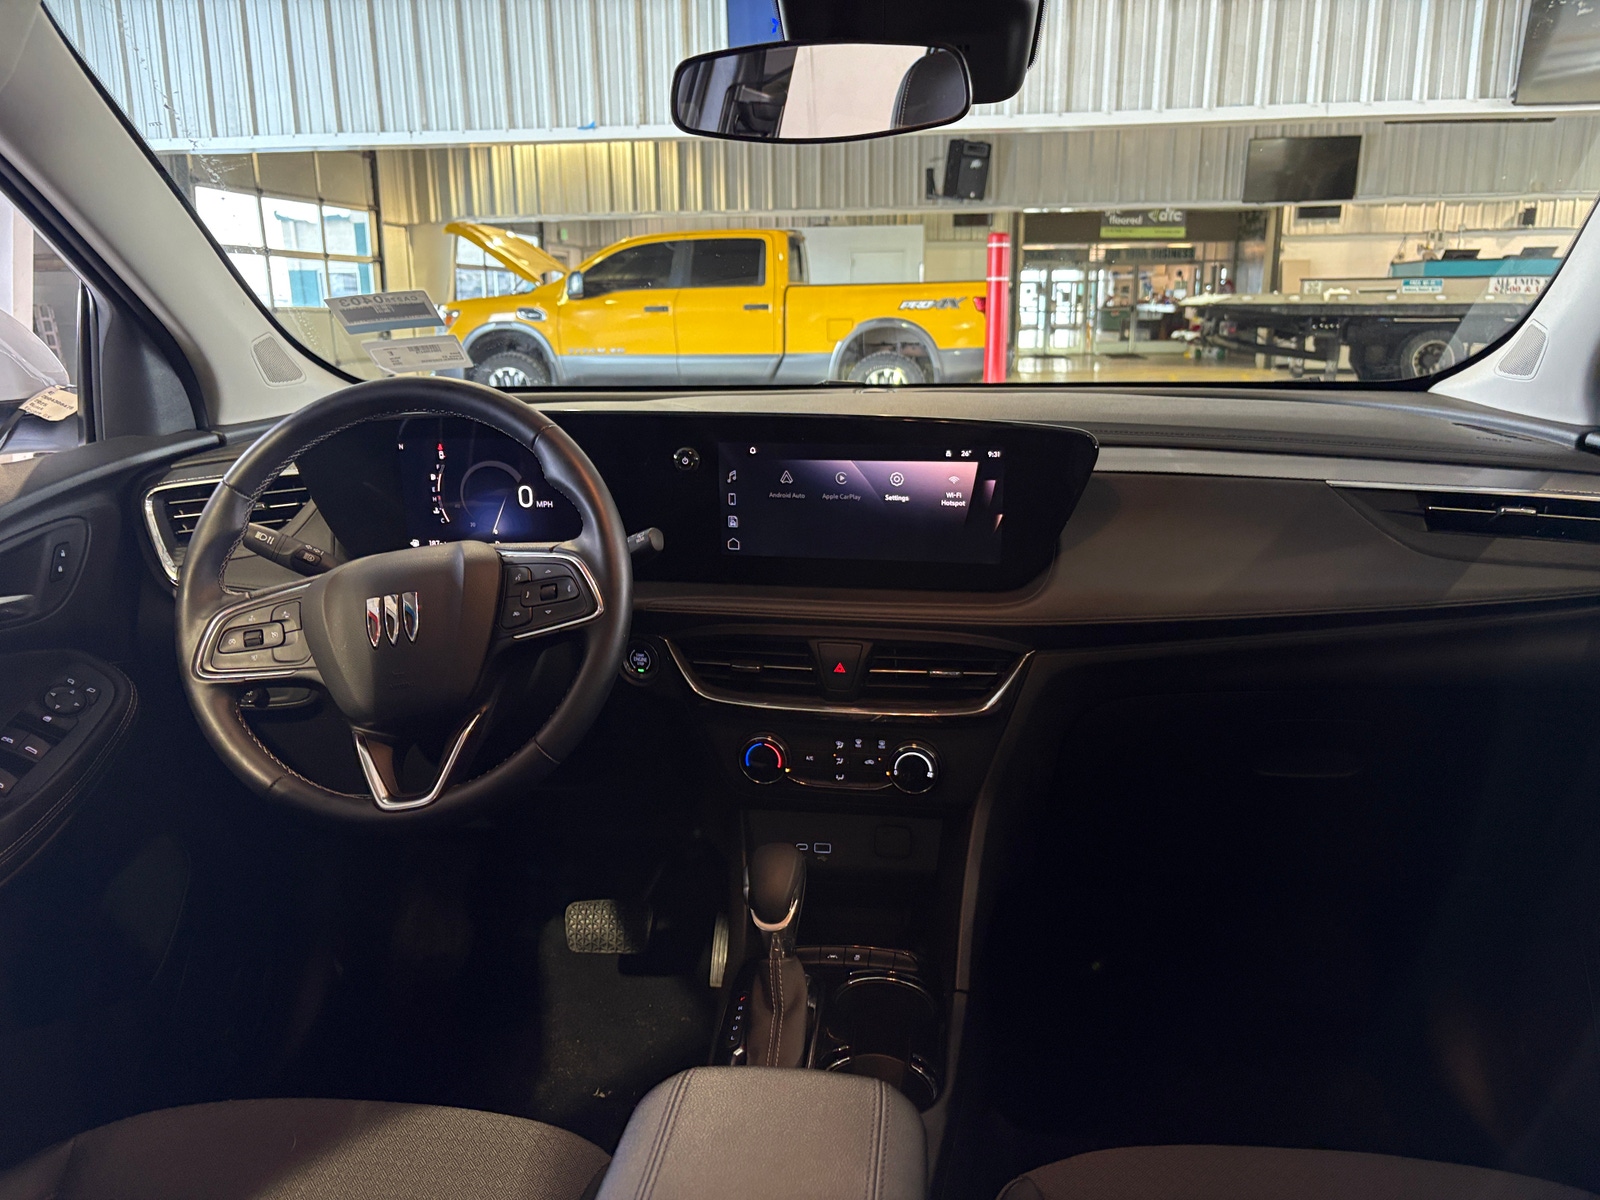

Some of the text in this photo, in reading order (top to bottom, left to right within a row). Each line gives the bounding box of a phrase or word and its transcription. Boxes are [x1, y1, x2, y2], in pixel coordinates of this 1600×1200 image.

[517, 485, 554, 509] 0 MPH
[769, 491, 791, 499] Android
[822, 493, 861, 501] Apple CarPlay
[885, 494, 909, 502] Settings
[945, 491, 962, 499] Wi-Fi
